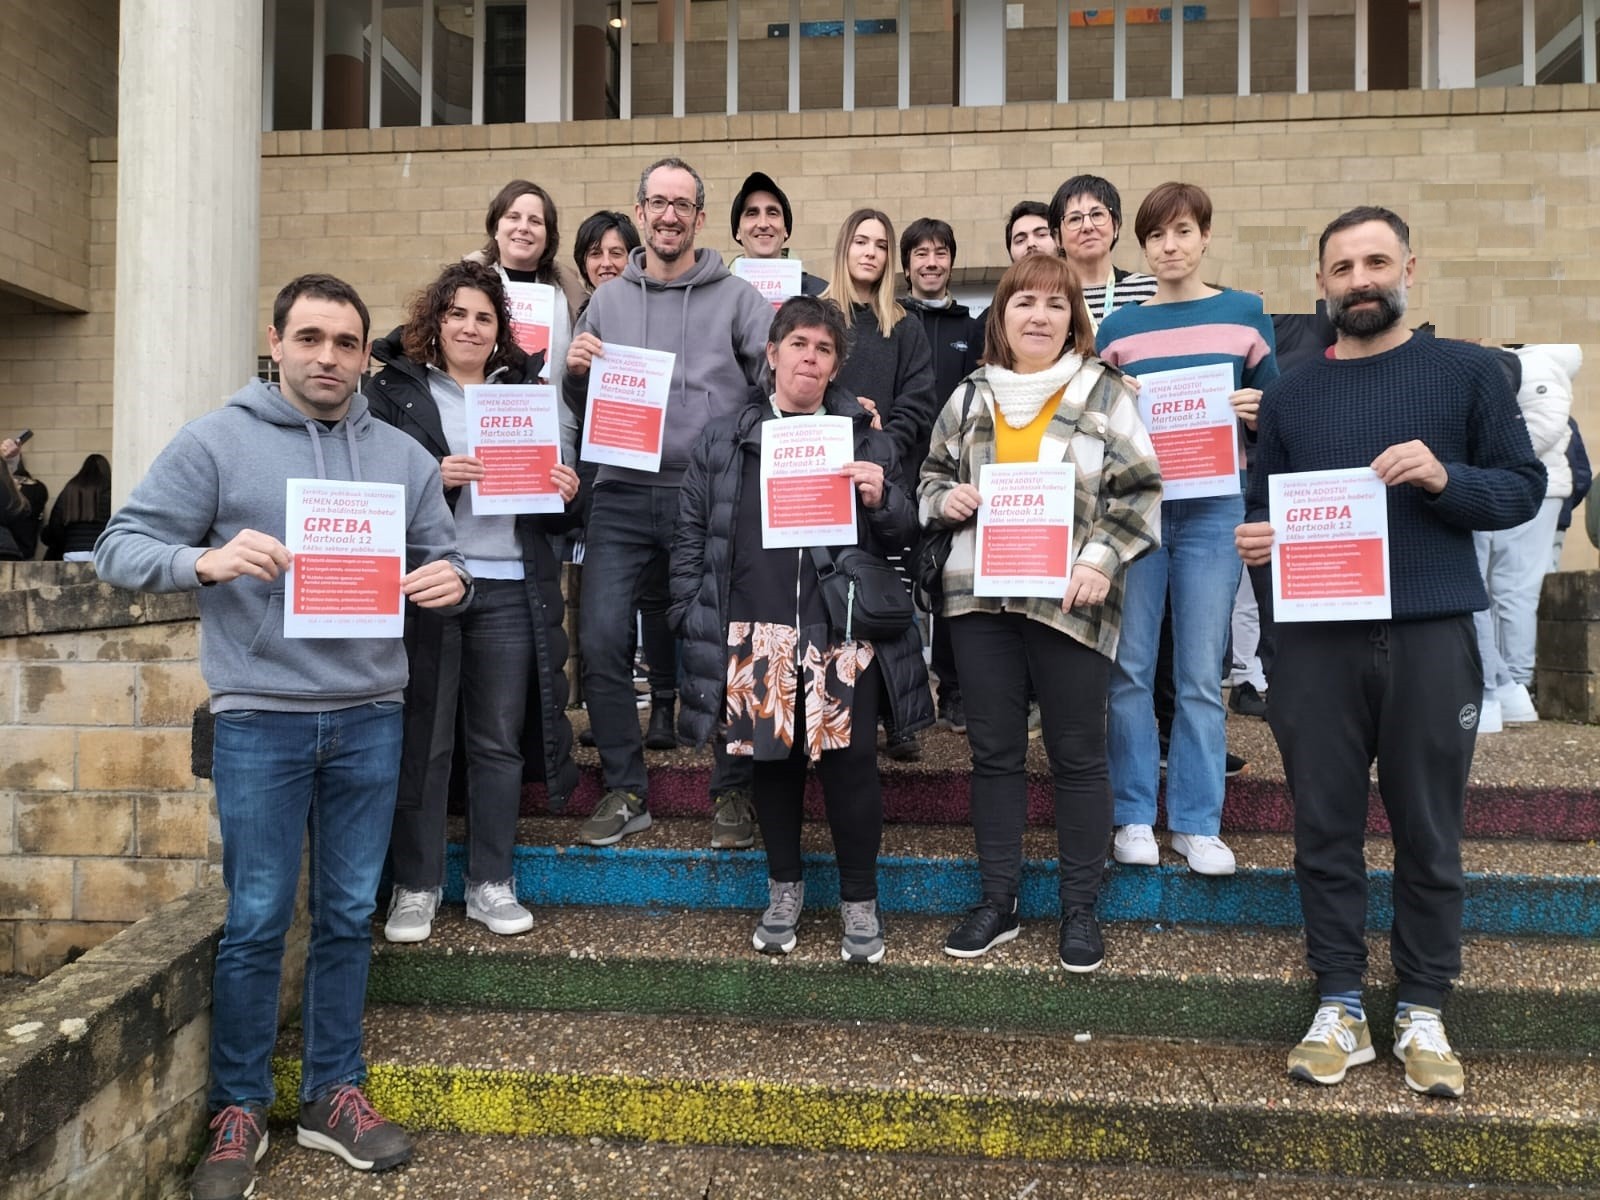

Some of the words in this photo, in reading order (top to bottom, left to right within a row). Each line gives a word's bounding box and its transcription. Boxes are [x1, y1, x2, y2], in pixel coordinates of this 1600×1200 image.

[602, 372, 646, 388] GREBA
[1149, 385, 1171, 393] HEMEN
[1152, 398, 1205, 415] GREBA
[481, 416, 533, 428] GREBA
[1152, 413, 1193, 424] Martxoak
[481, 430, 520, 438] Martxoak
[774, 446, 825, 459] GREBA
[303, 497, 330, 505] HEMEN
[991, 494, 1045, 506] GREBA
[990, 508, 1030, 516] Martxoak
[1287, 505, 1352, 522] GREBA
[304, 518, 372, 533] GREBA
[1286, 521, 1336, 532] Martxoak
[1340, 521, 1352, 529] 12
[303, 534, 355, 544] Martxoak
[359, 536, 372, 544] 12
